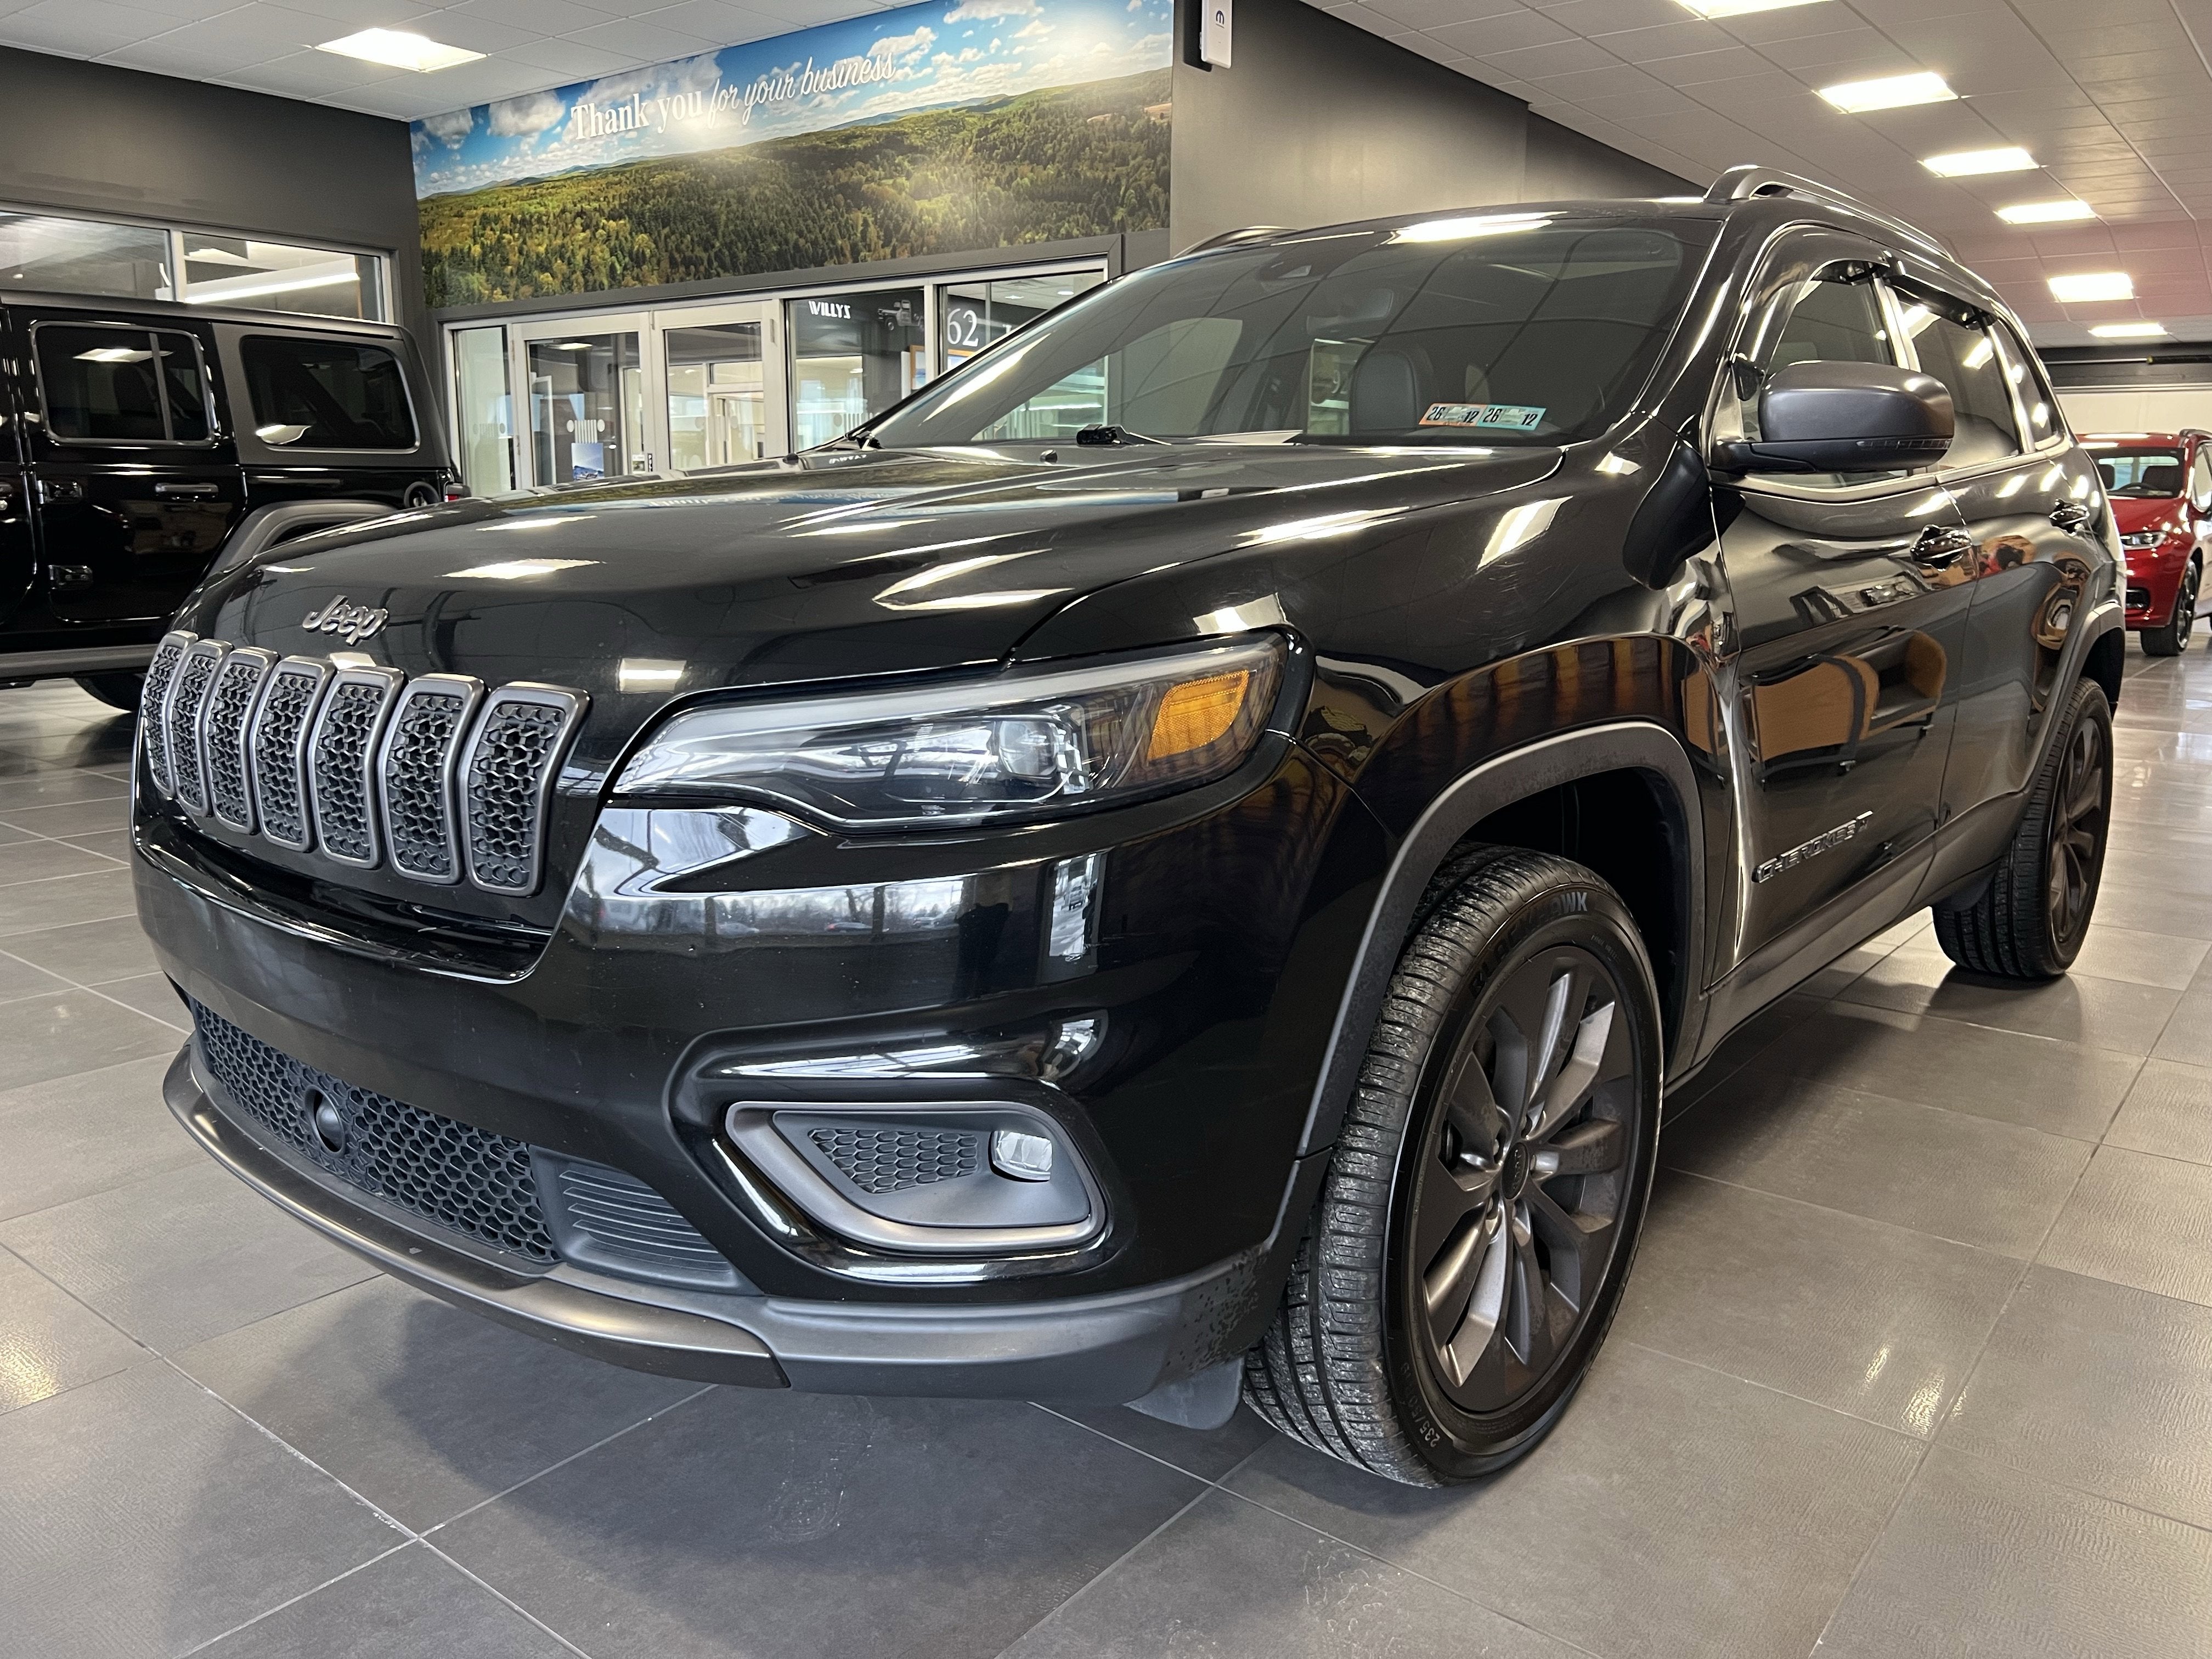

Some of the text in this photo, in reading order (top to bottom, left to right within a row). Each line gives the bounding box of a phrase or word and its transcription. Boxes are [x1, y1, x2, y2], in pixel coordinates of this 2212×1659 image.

[571, 52, 896, 140] Thank you for your business
[808, 300, 851, 319] WILLYS
[947, 308, 979, 347] 62
[1426, 407, 1480, 424] 26 12
[1482, 408, 1538, 426] 26 12
[302, 595, 388, 645] Jeep
